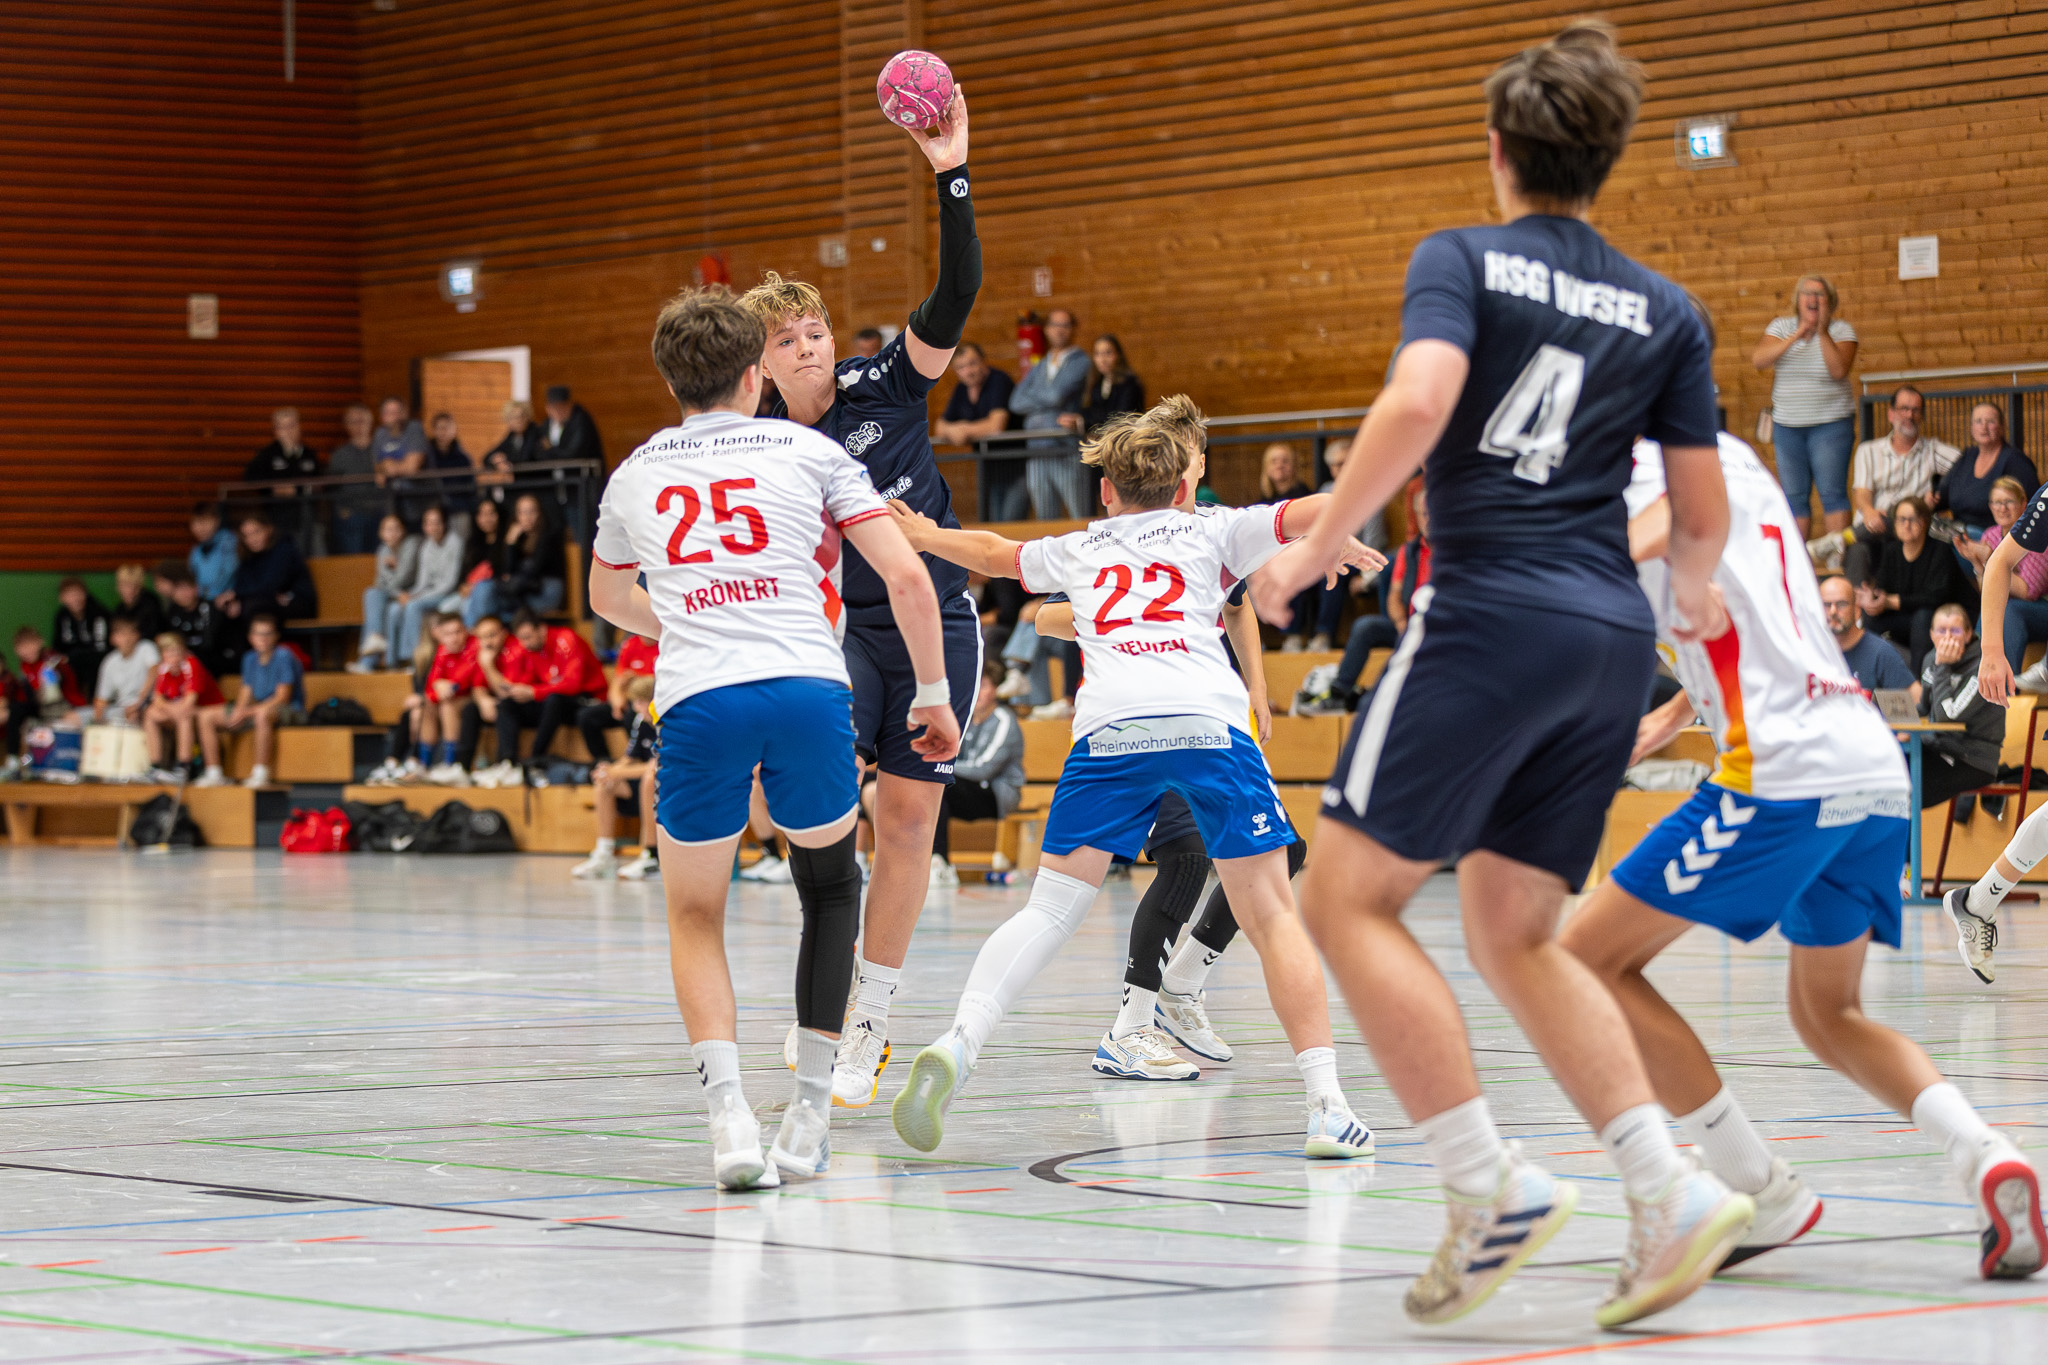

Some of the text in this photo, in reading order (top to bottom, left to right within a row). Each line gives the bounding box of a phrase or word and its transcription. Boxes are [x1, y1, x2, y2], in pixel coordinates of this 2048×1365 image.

[1484, 250, 1550, 304] HSG
[1477, 343, 1585, 485] 4
[714, 435, 792, 446] Handball
[656, 478, 769, 565] 25
[682, 577, 779, 615] KRÖNERT
[1093, 562, 1186, 635] 22
[1092, 733, 1230, 753] Rheinwohnungsbau
[934, 763, 953, 774] JAKO
